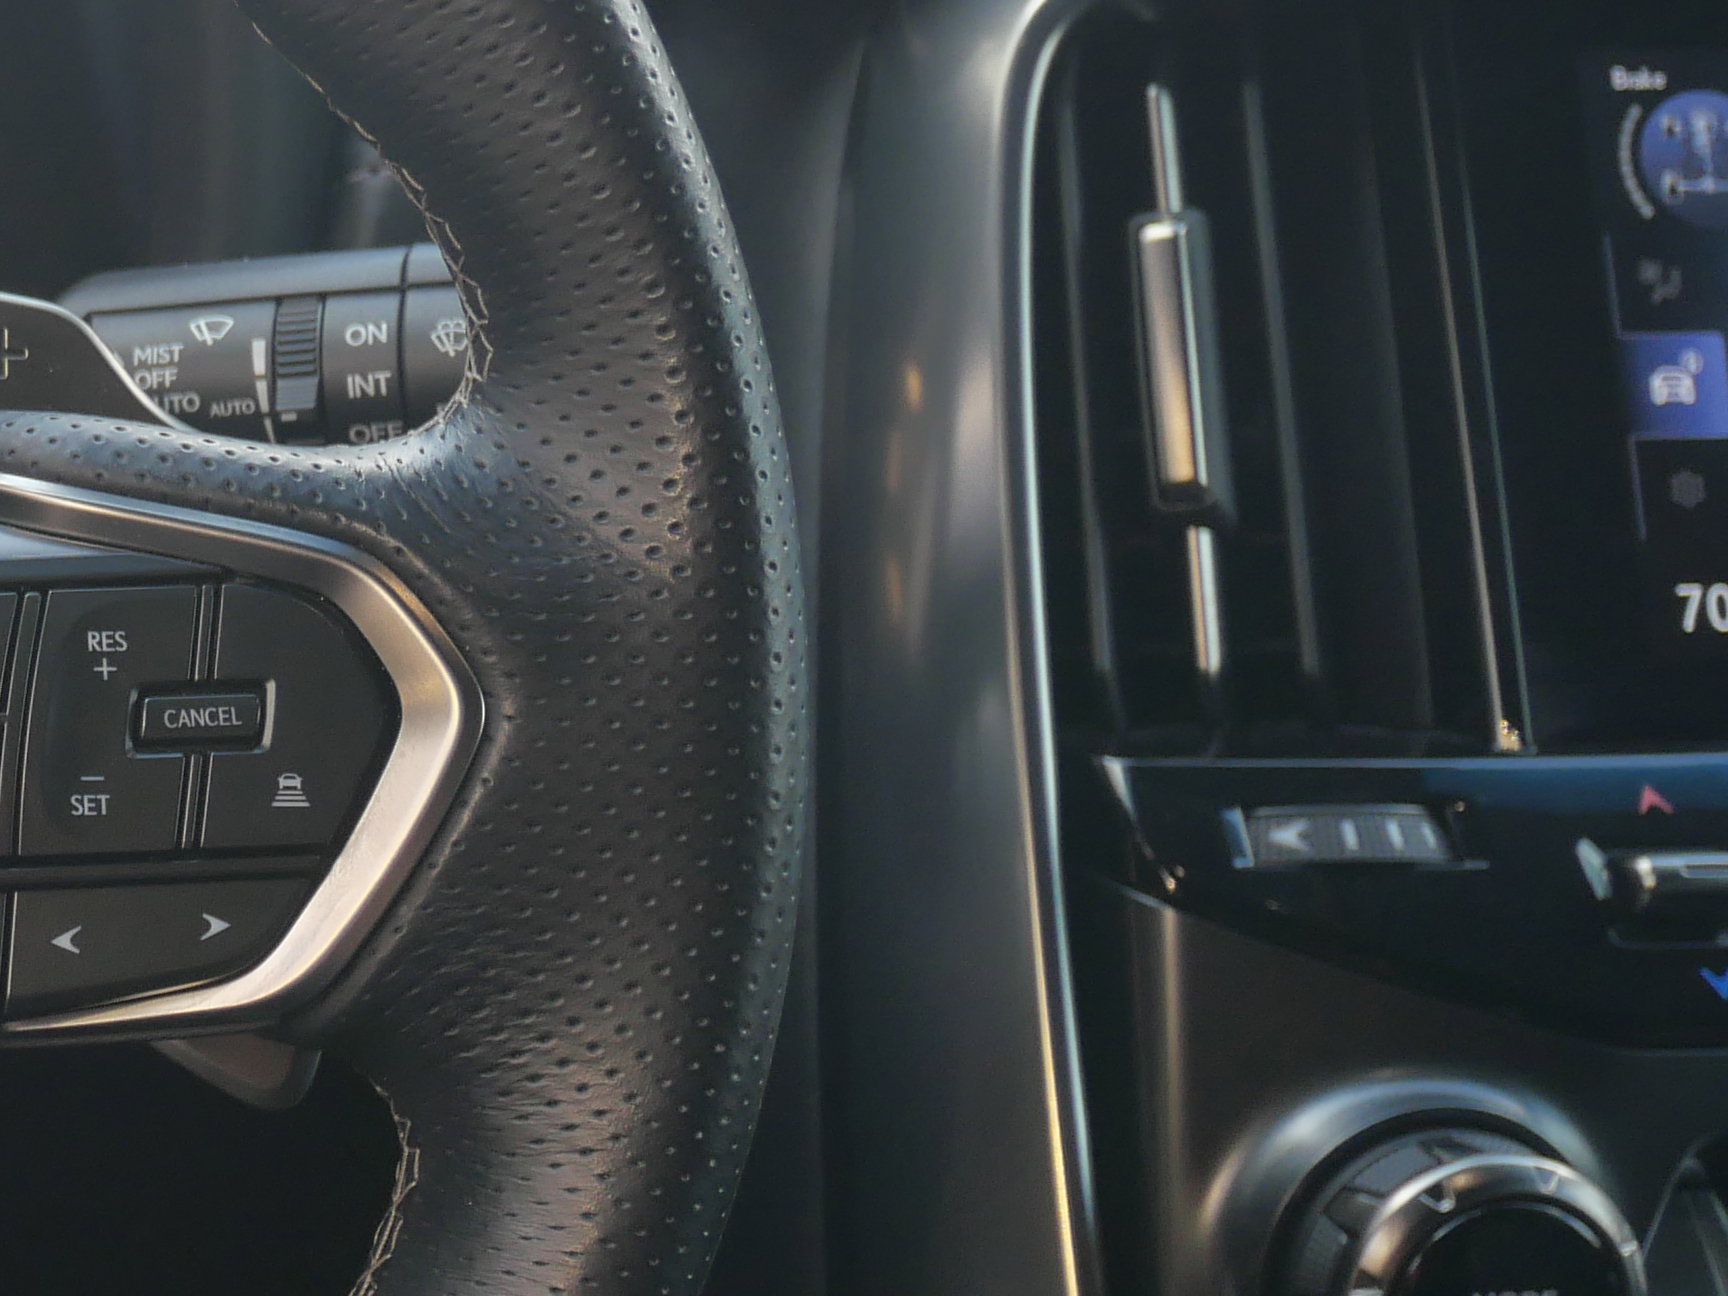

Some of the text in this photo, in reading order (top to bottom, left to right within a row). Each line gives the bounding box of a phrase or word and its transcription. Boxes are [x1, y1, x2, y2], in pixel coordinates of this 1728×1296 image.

[345, 322, 389, 347] ON
[133, 342, 184, 366] MIST
[134, 366, 178, 390] OFF
[347, 371, 392, 401] INT
[152, 391, 201, 416] UTO
[209, 397, 256, 418] AUTO
[1675, 584, 1728, 634] 70
[87, 631, 128, 654] RES
[163, 706, 244, 731] CANCEL
[70, 794, 111, 817] SET
